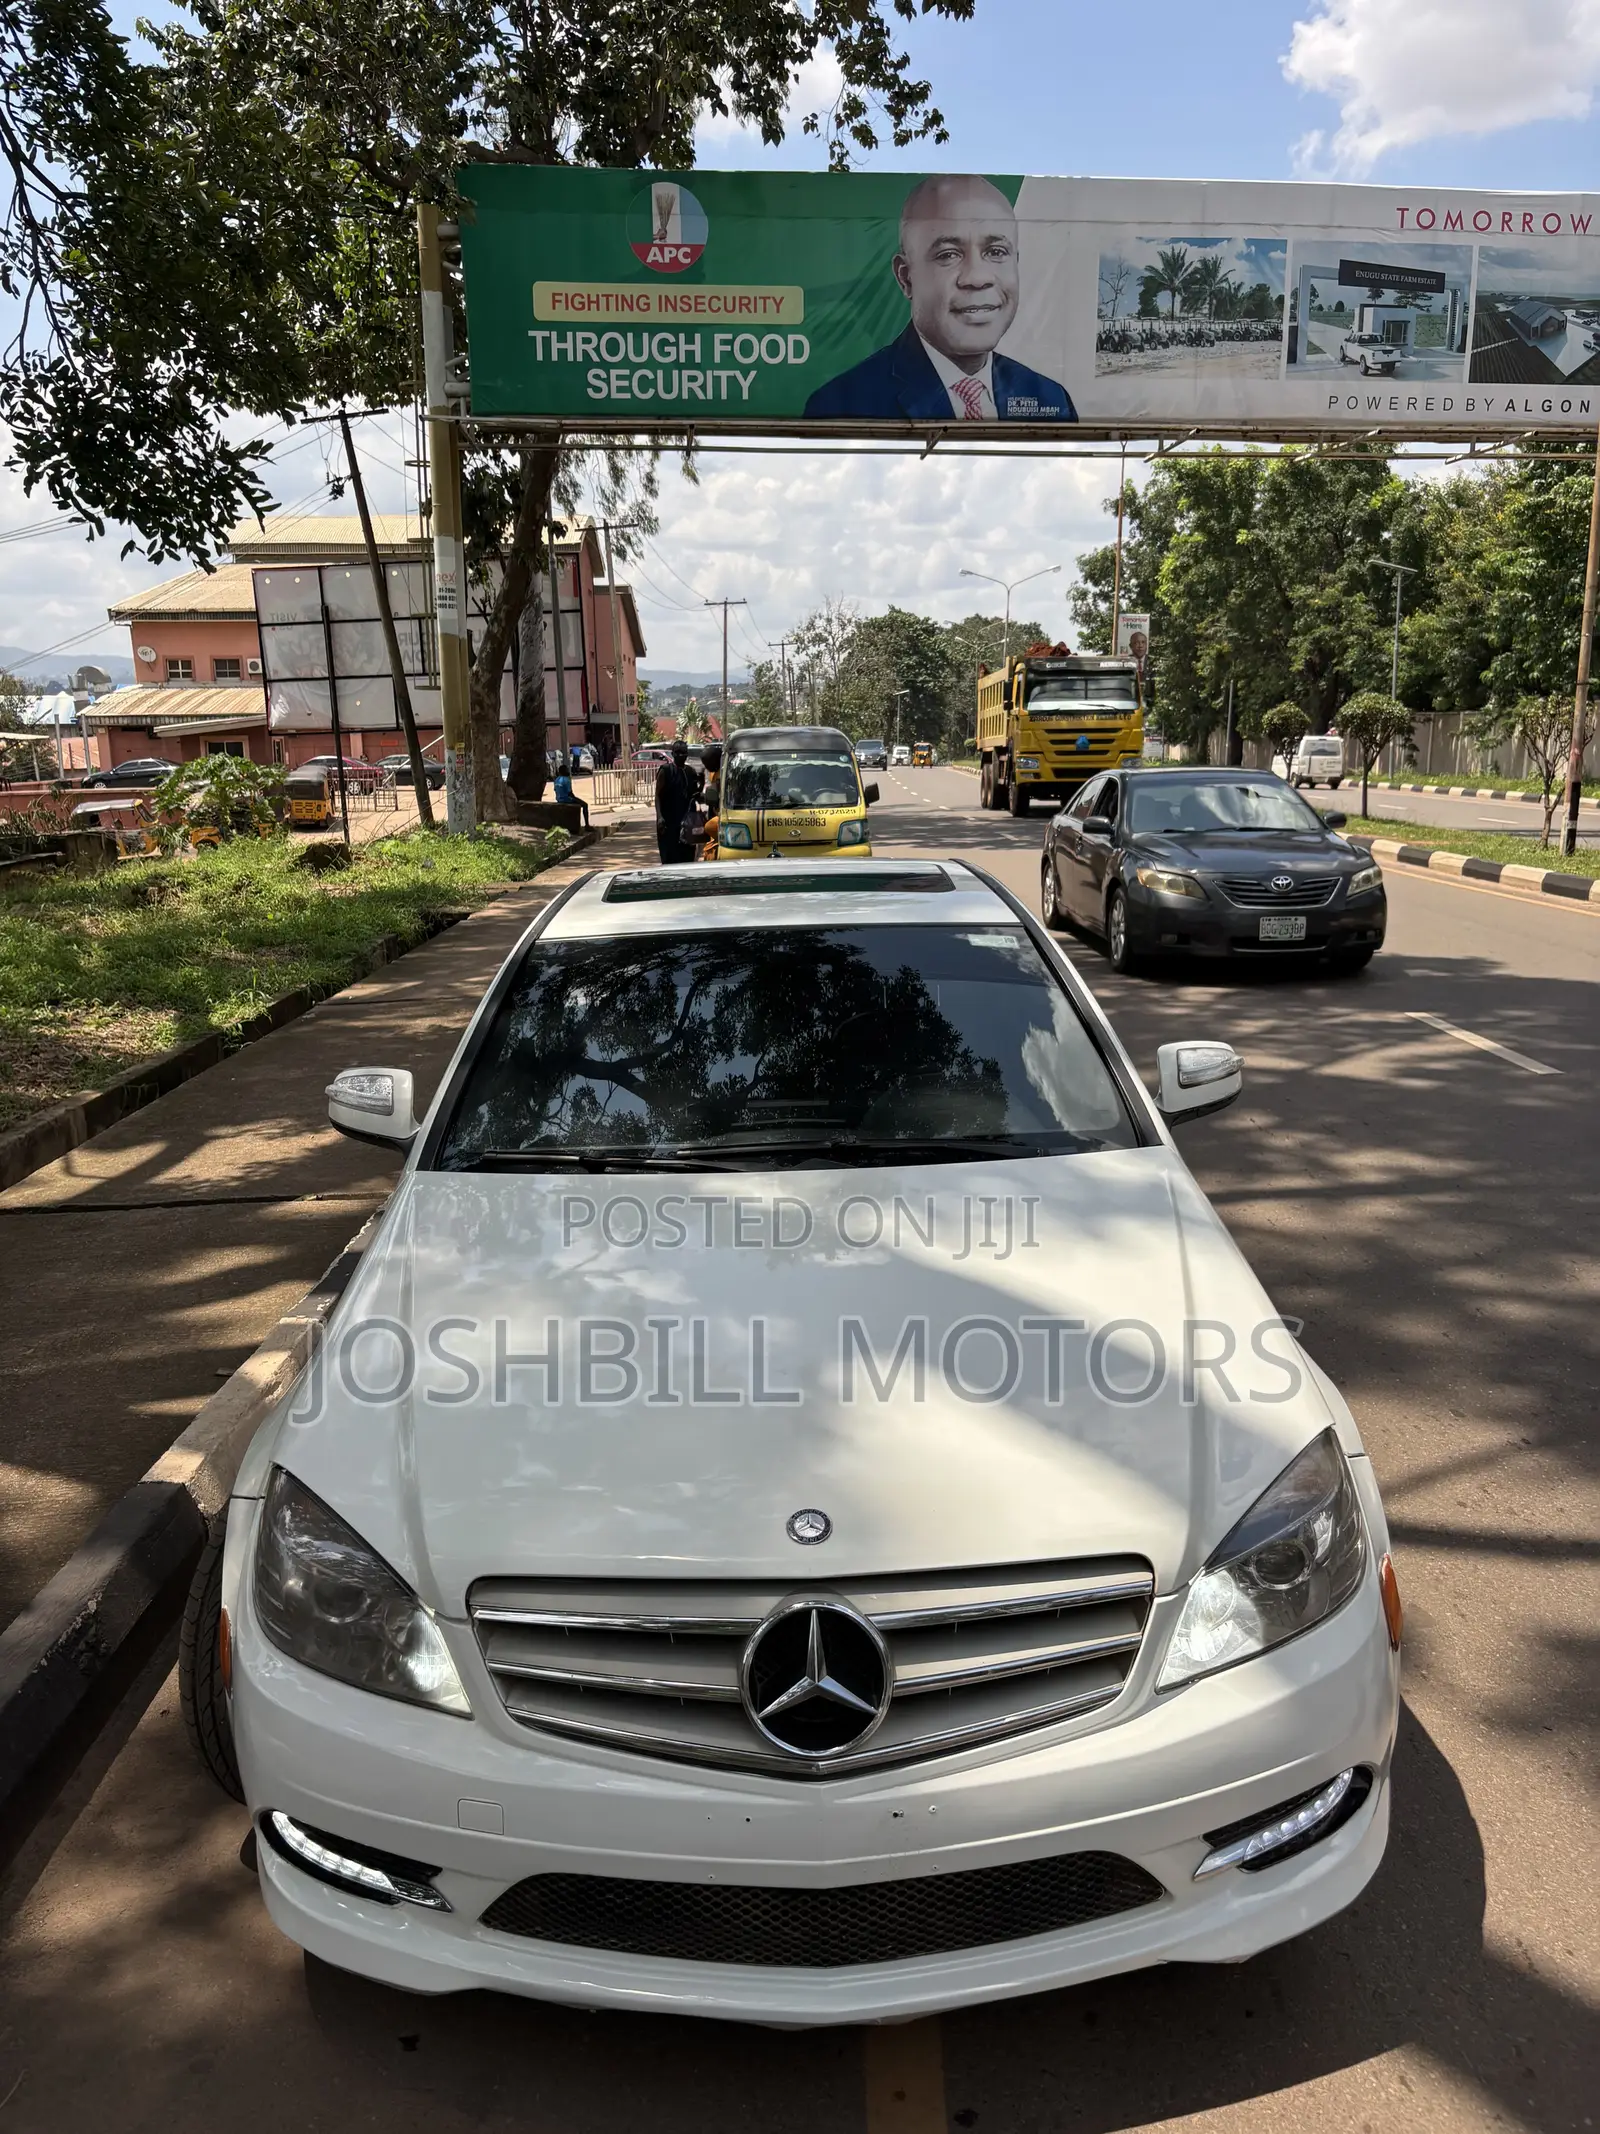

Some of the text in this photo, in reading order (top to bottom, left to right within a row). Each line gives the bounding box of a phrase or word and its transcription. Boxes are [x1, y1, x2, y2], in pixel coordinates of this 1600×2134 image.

[1396, 207, 1593, 235] TOMORROW
[646, 246, 691, 264] APC
[1355, 270, 1437, 285] ENUGU STATE FARM ESTATE
[551, 292, 785, 314] FIGHTING INSECURITY
[528, 330, 811, 364] THROUGH FOOD
[586, 368, 757, 400] SECURITY
[1328, 395, 1591, 413] POWERED BY ALGON
